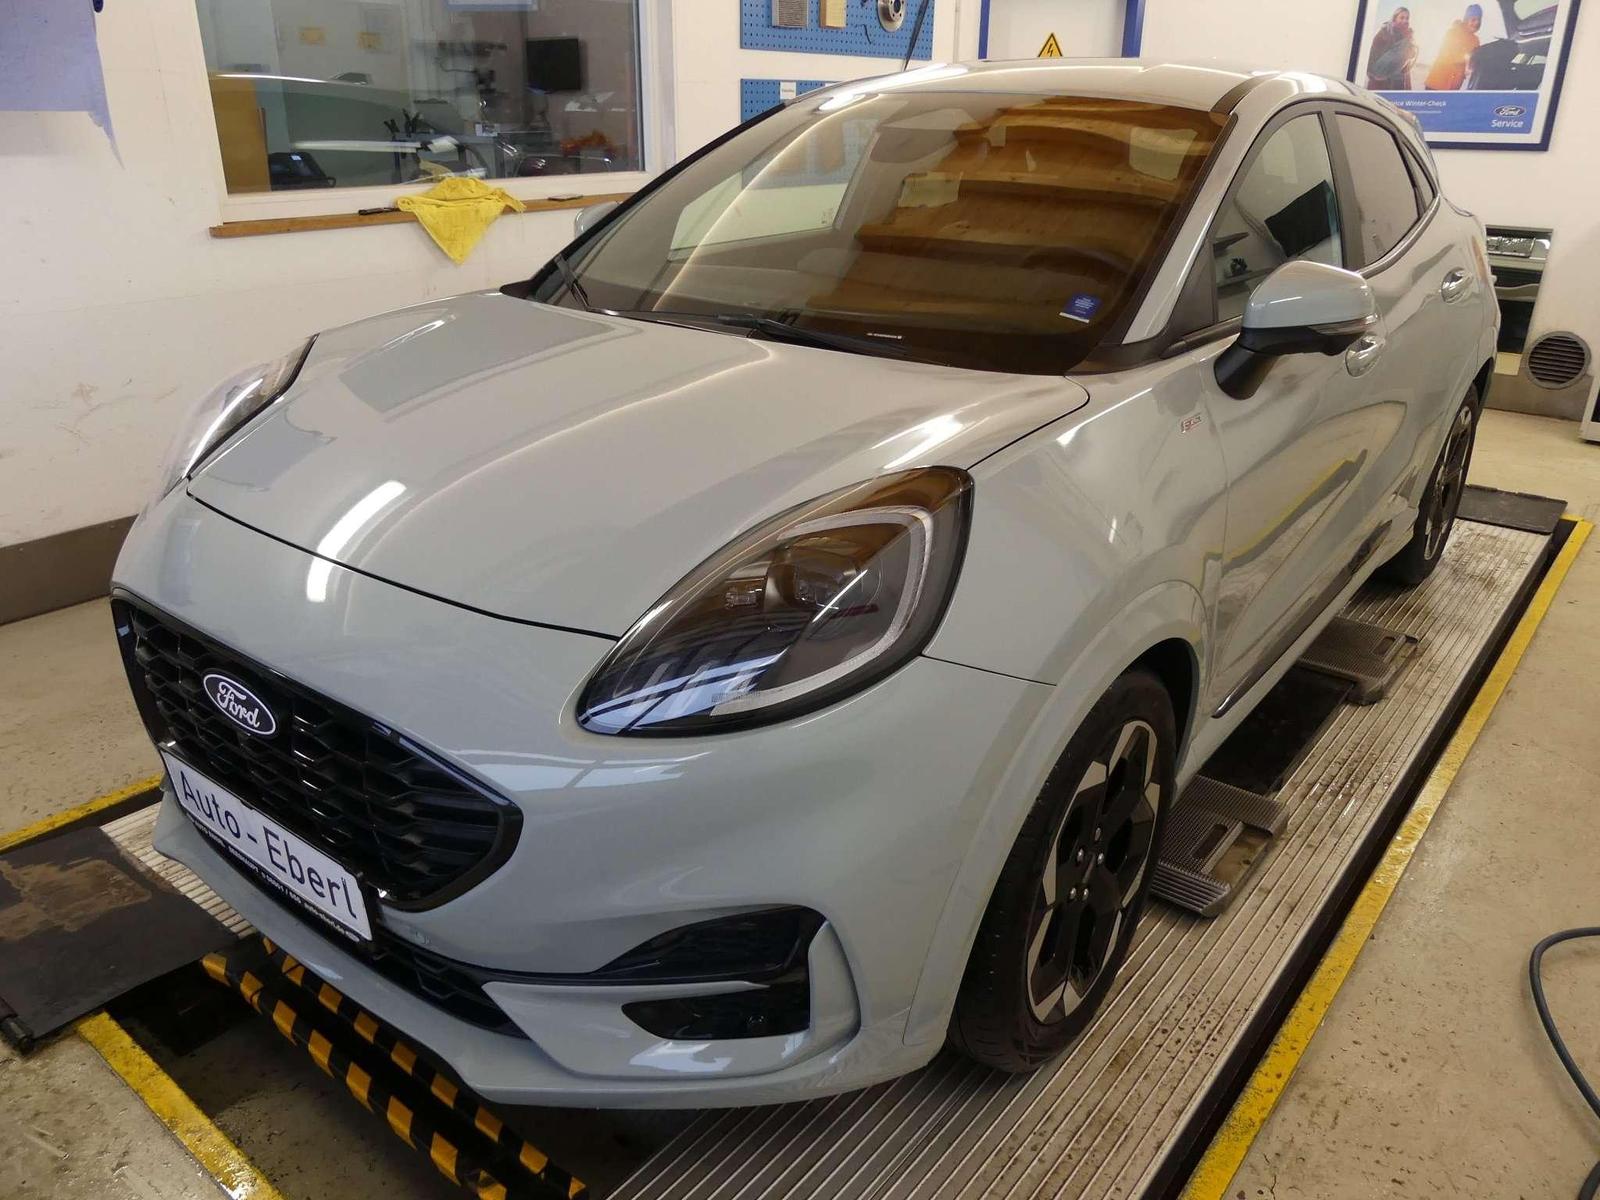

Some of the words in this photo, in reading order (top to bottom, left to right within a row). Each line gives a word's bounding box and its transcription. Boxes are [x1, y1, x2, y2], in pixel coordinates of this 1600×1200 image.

[1491, 119, 1524, 128] Service
[216, 681, 262, 729] Ford
[180, 770, 240, 839] Auto
[263, 825, 357, 919] Eberl
